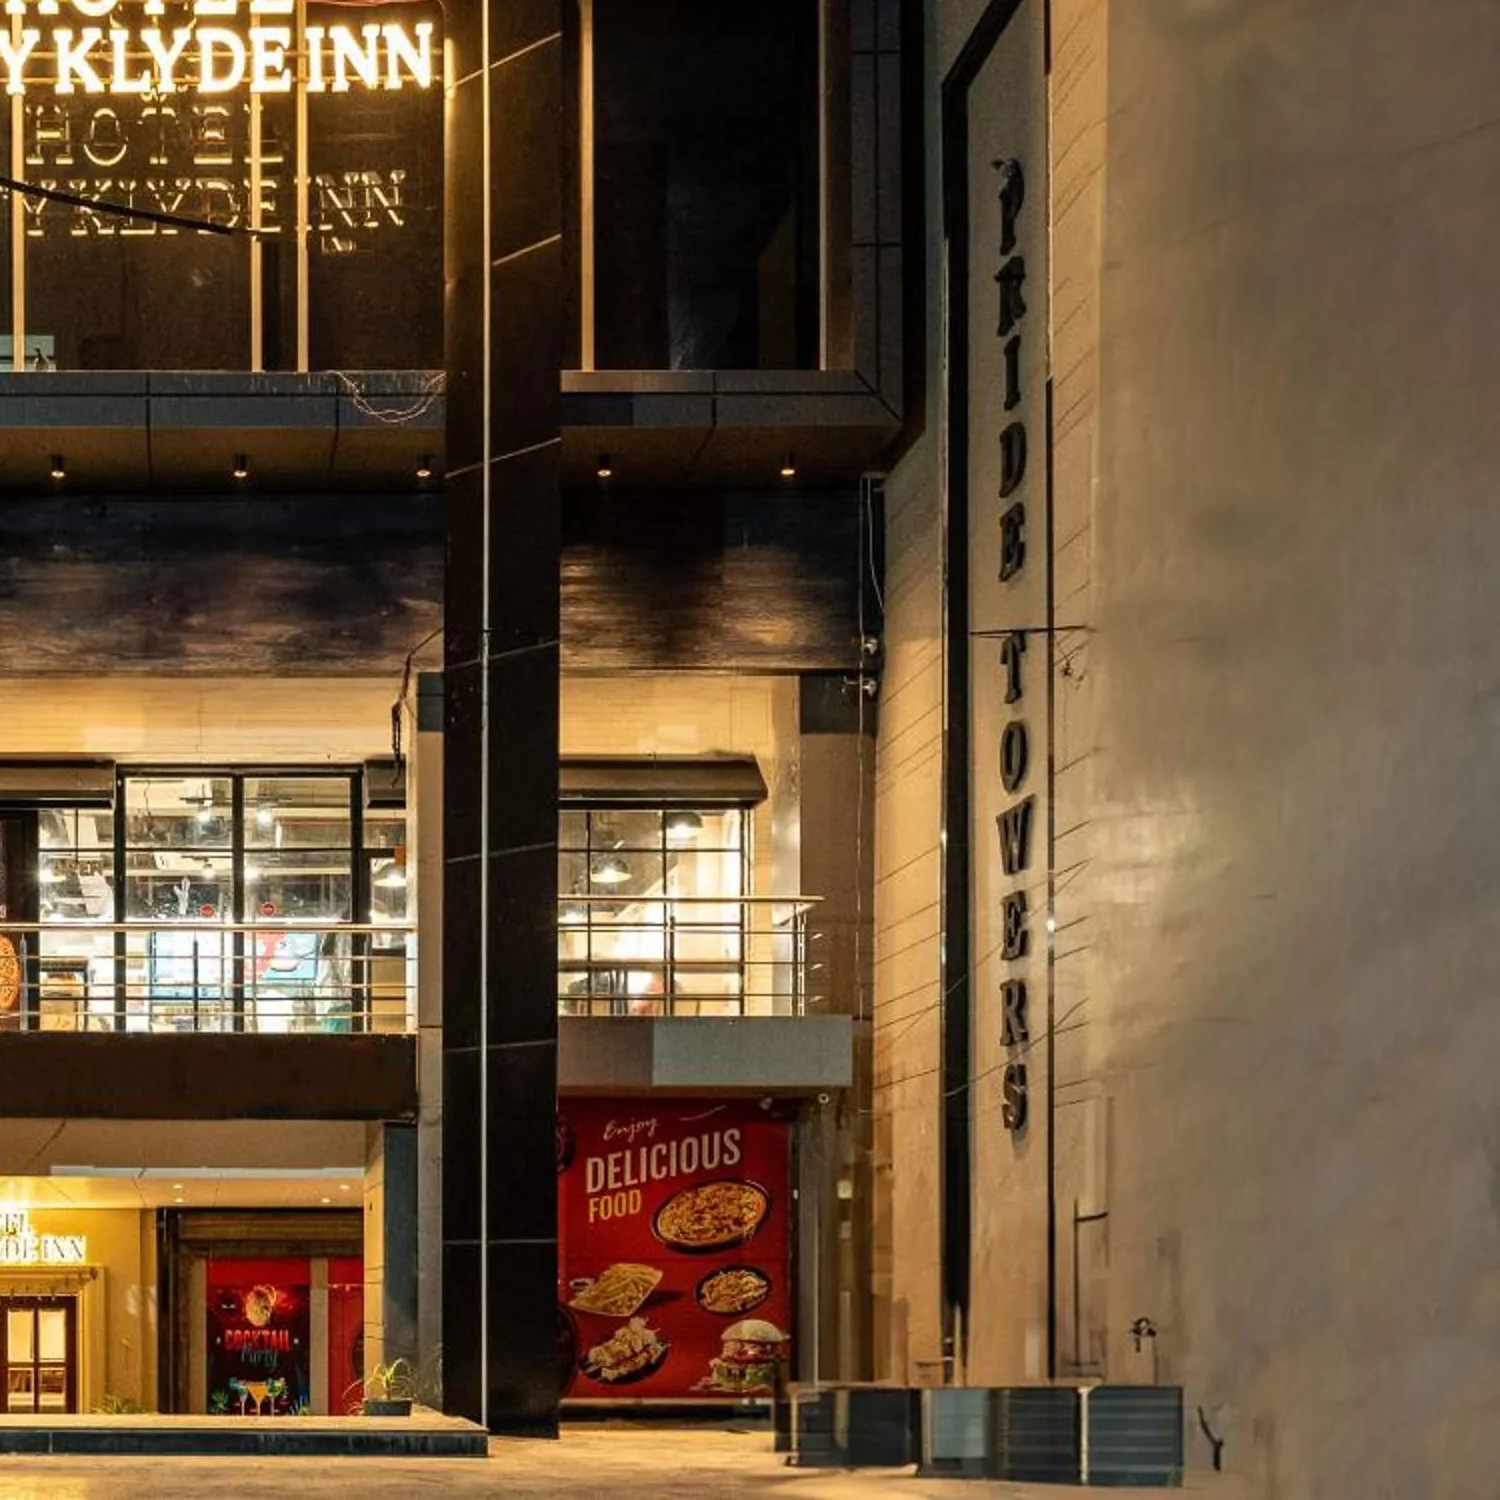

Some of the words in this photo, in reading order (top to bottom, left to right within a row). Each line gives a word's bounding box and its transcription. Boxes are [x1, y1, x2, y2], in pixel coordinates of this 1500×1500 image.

[54, 26, 292, 94] KLYDE
[305, 22, 434, 94] INN
[993, 155, 1028, 583] PRIDE
[995, 630, 1036, 1130] TOWERS
[586, 1127, 741, 1194] DELICIOUS
[602, 1117, 660, 1142] Enjoy
[588, 1188, 642, 1224] FOOD
[224, 1329, 290, 1351] COCKTAIL
